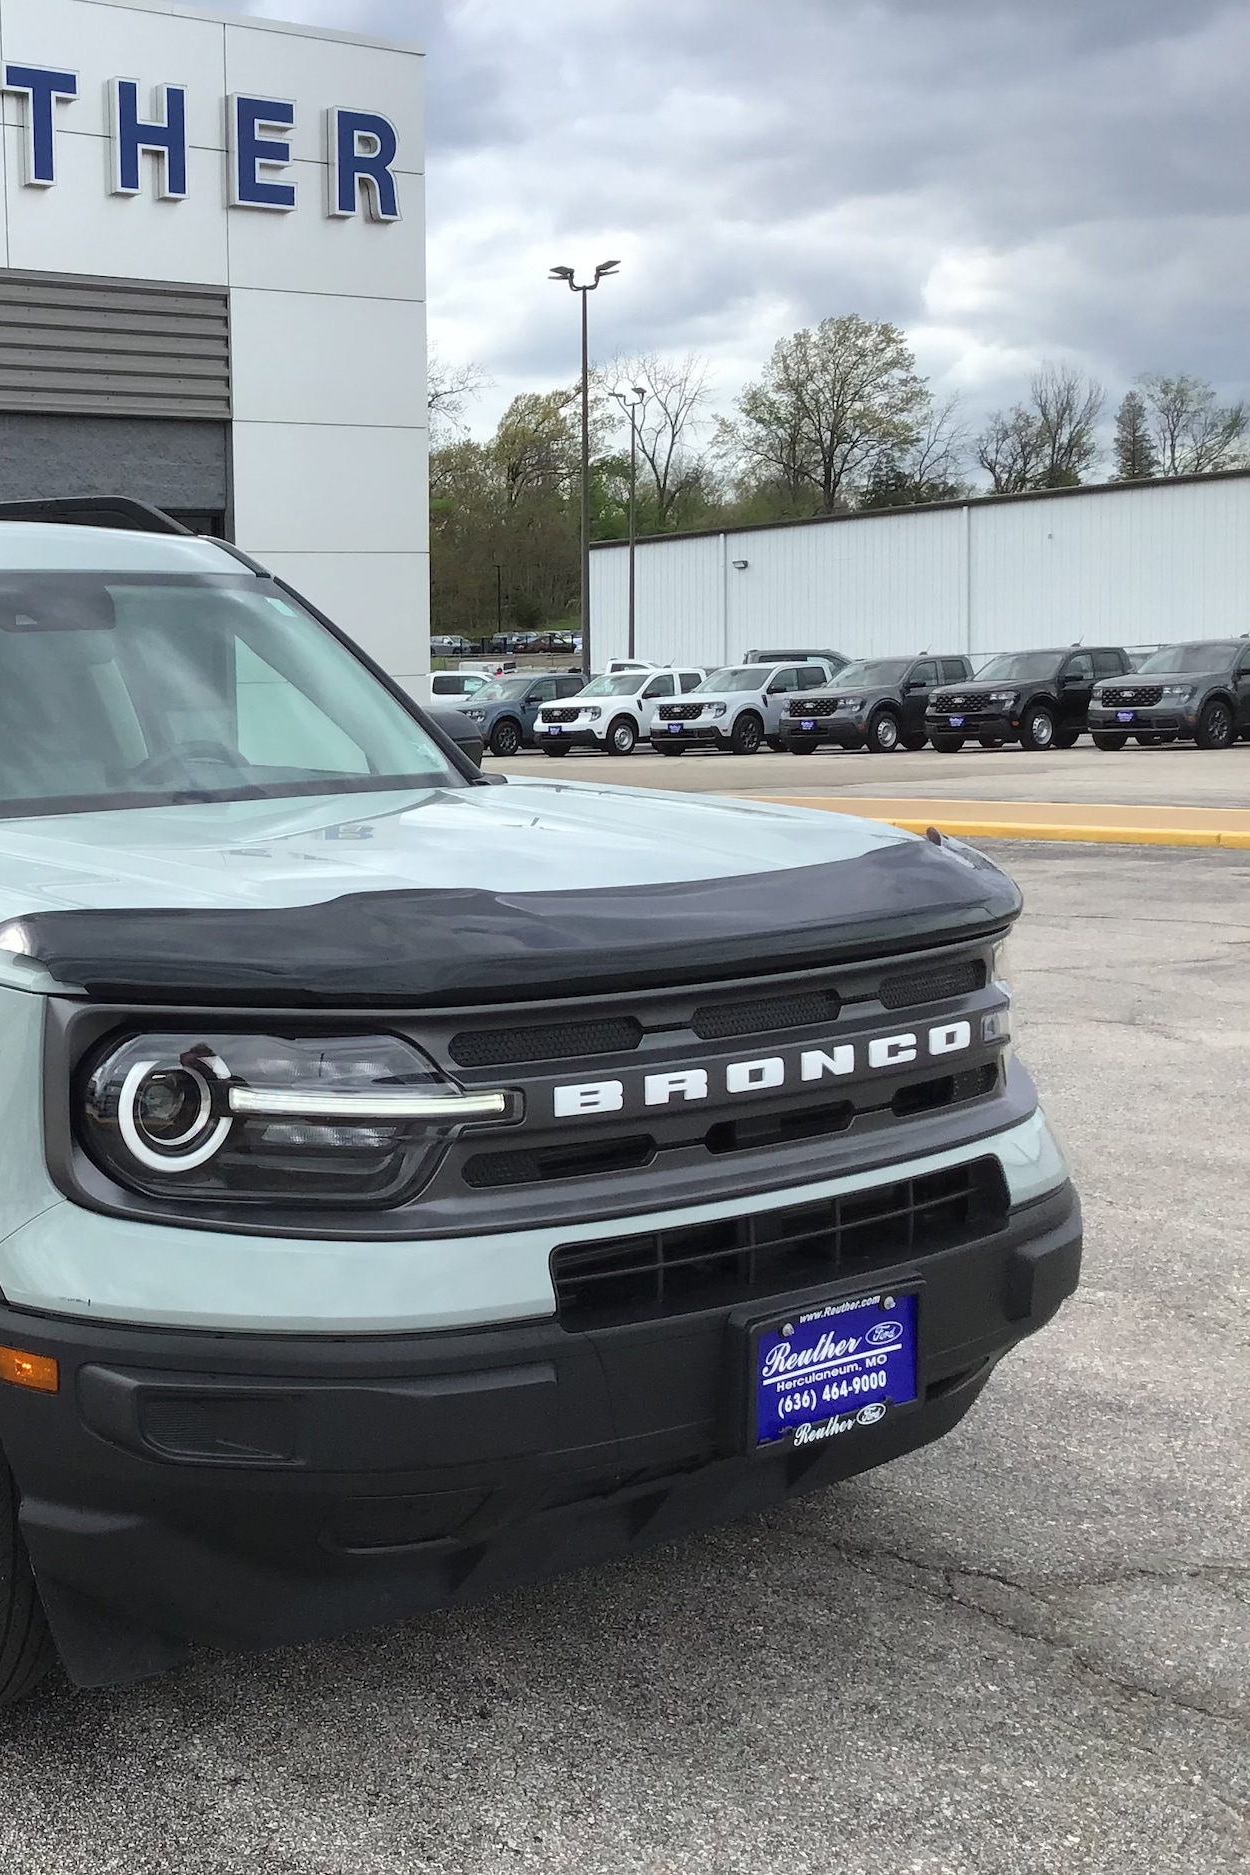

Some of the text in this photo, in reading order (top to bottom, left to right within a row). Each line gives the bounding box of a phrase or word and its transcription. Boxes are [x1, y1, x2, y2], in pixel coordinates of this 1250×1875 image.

[553, 1020, 972, 1117] BRONCO
[799, 1295, 881, 1323] www.Reuther.com
[762, 1331, 862, 1377] Reuther
[776, 1354, 888, 1393] Herculaneum, MO
[778, 1370, 887, 1419] (636) 464-9000
[794, 1415, 857, 1446] Reuther
